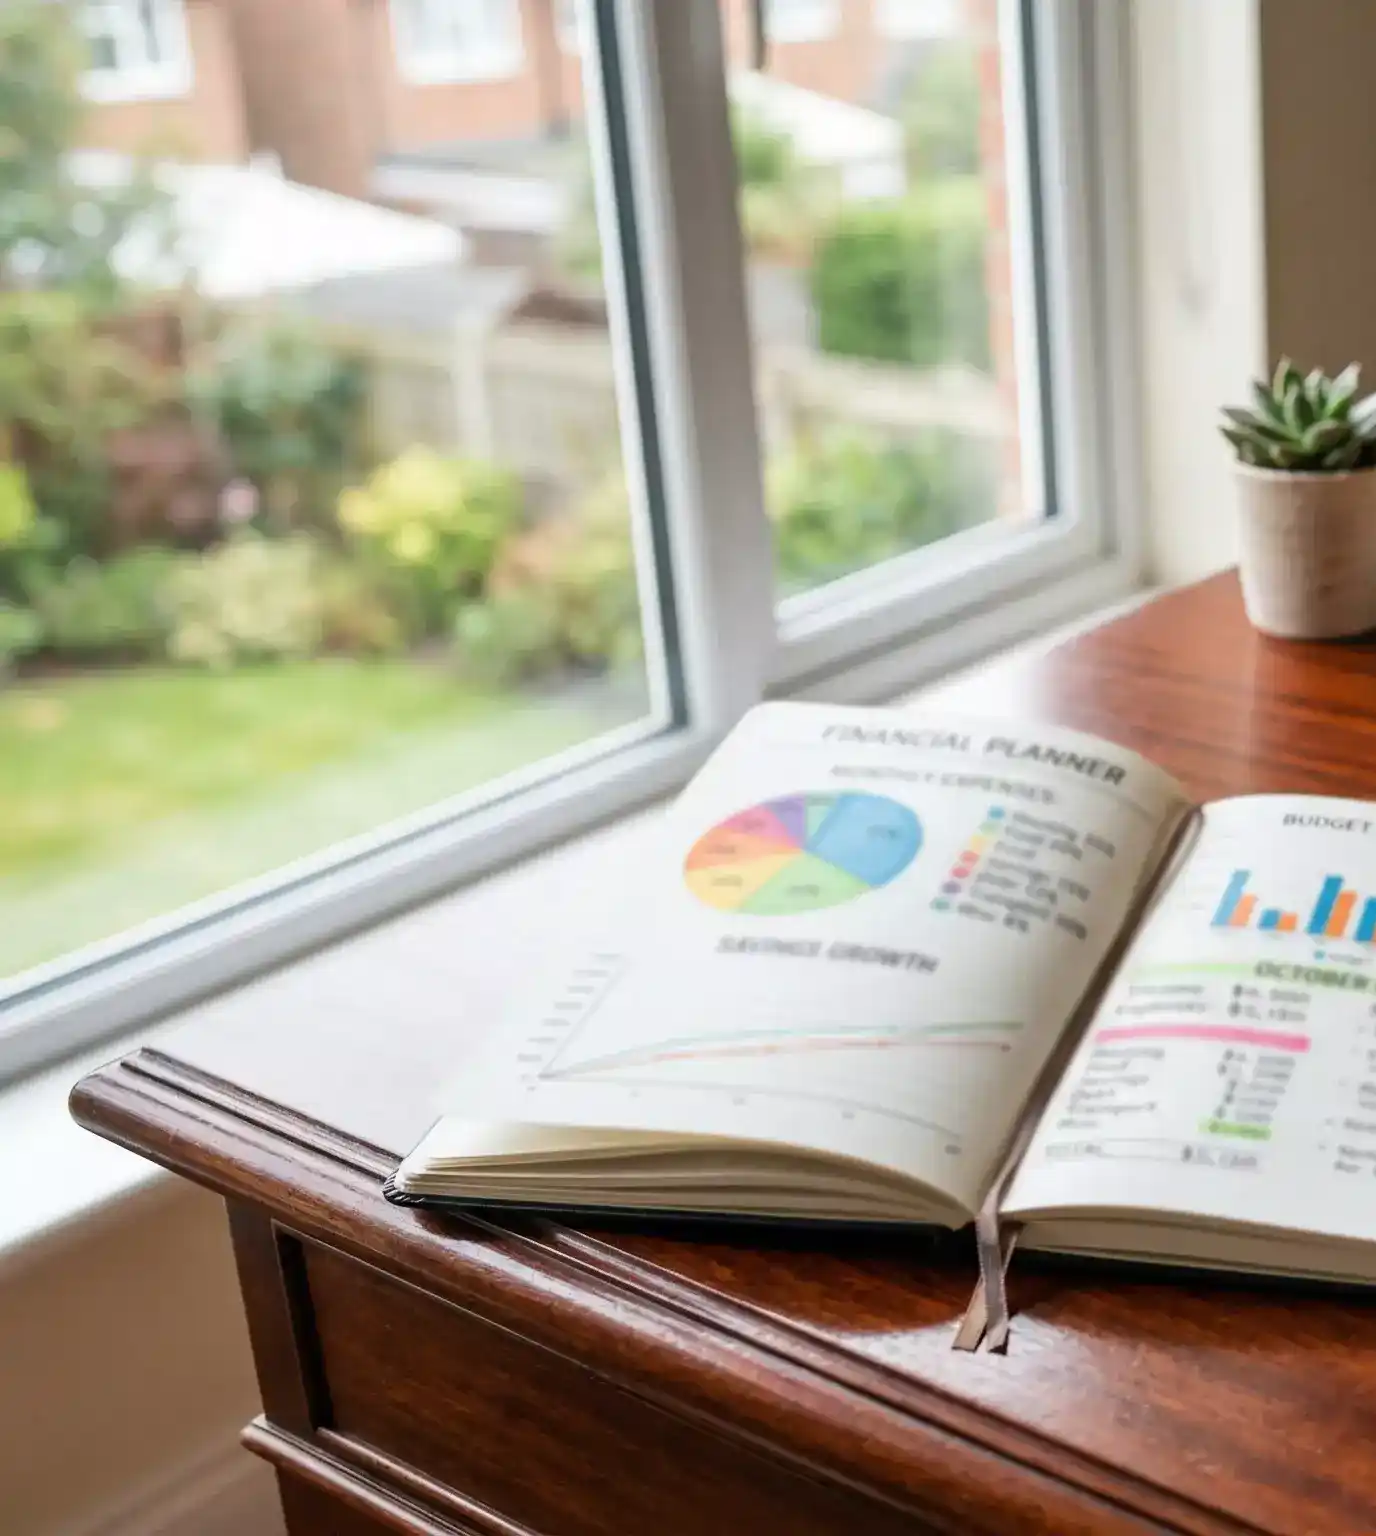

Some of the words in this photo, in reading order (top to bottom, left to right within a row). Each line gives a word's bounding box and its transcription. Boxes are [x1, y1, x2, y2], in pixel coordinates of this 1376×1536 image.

[983, 736, 1127, 786] PLANNER
[1282, 811, 1375, 834] BUDGET
[1254, 959, 1371, 992] OCTOBER
